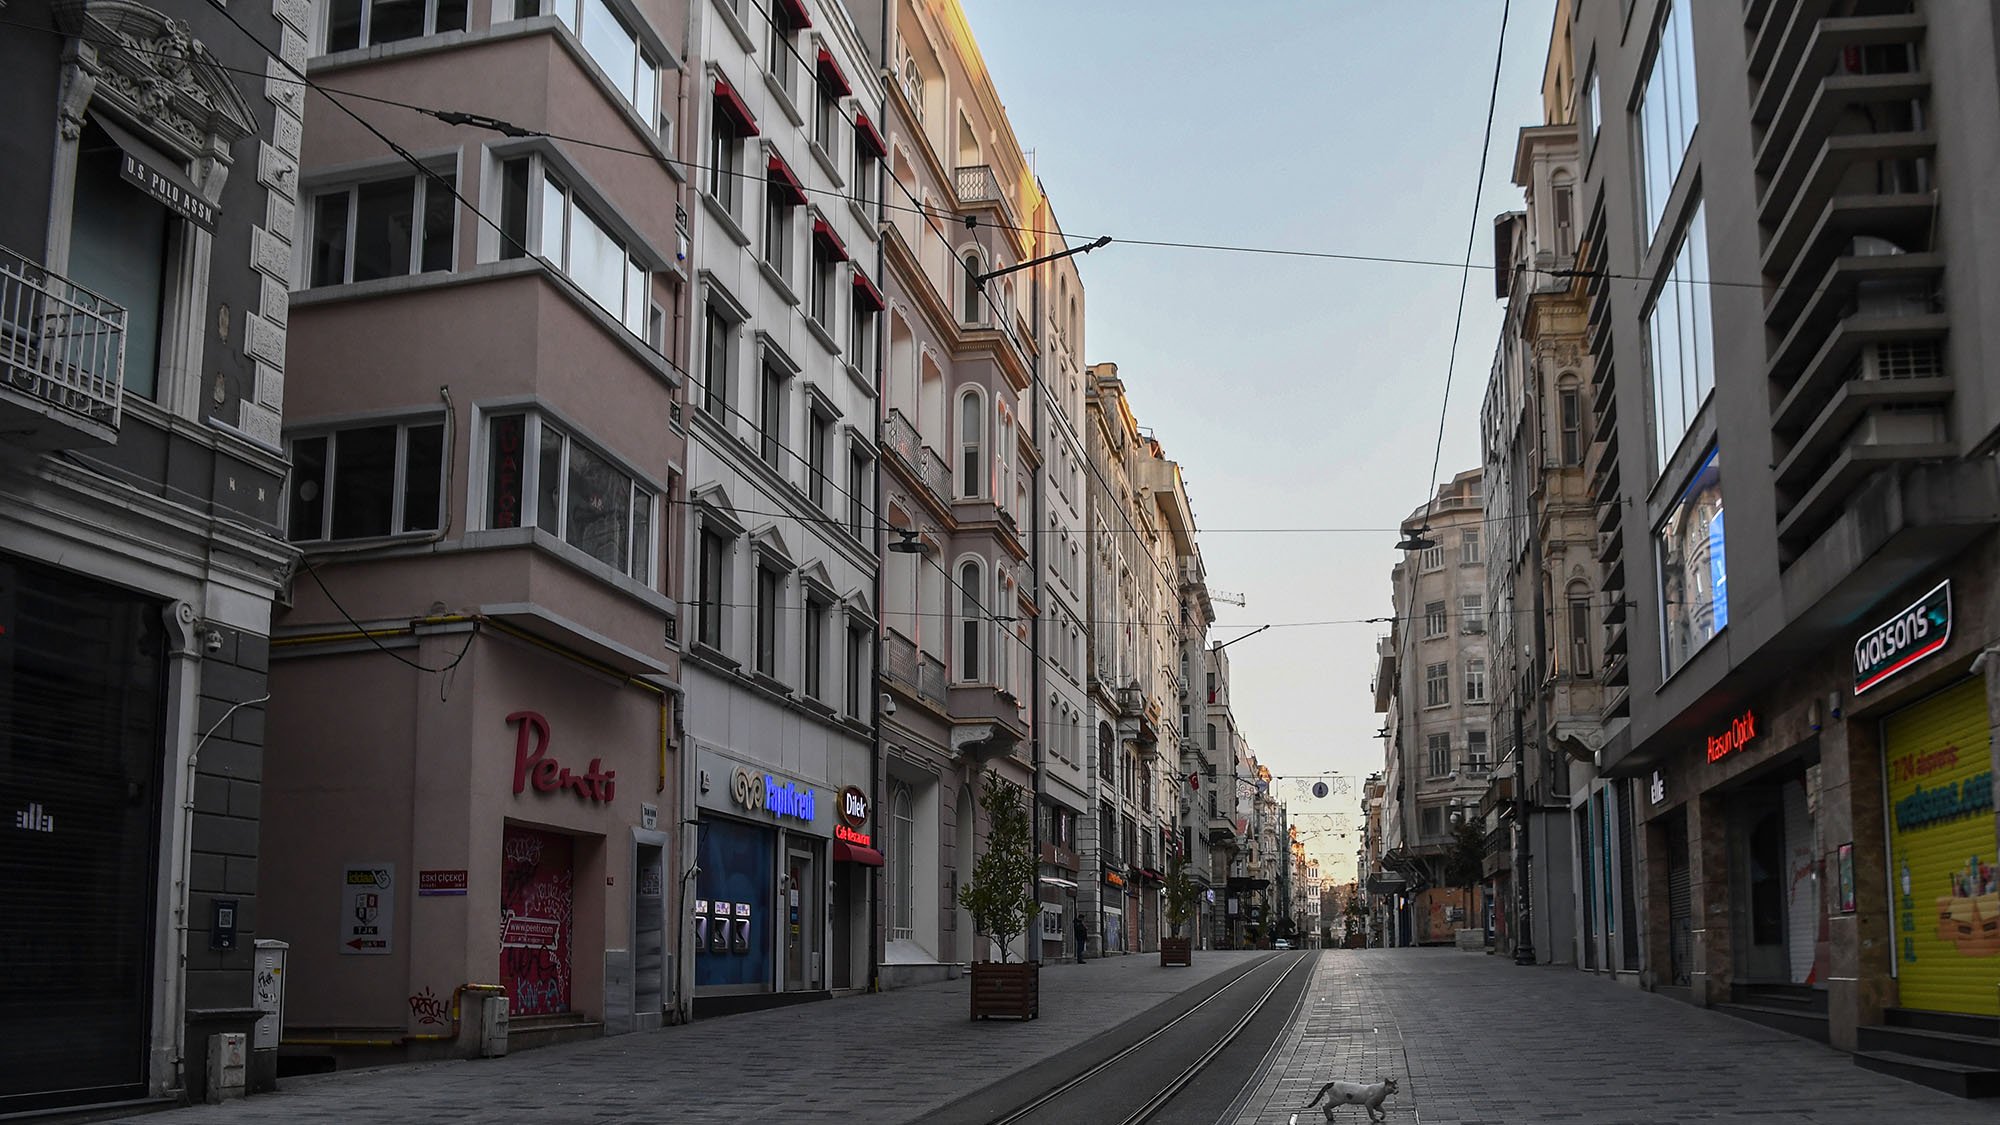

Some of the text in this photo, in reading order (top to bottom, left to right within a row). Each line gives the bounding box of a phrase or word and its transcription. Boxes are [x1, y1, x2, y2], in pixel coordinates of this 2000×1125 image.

[127, 156, 214, 225] U.S. POLO ASSN.
[1855, 605, 1929, 673] watsons
[505, 711, 616, 803] Penti
[1707, 709, 1755, 764] Atasun Optik
[846, 793, 865, 818] Dilek
